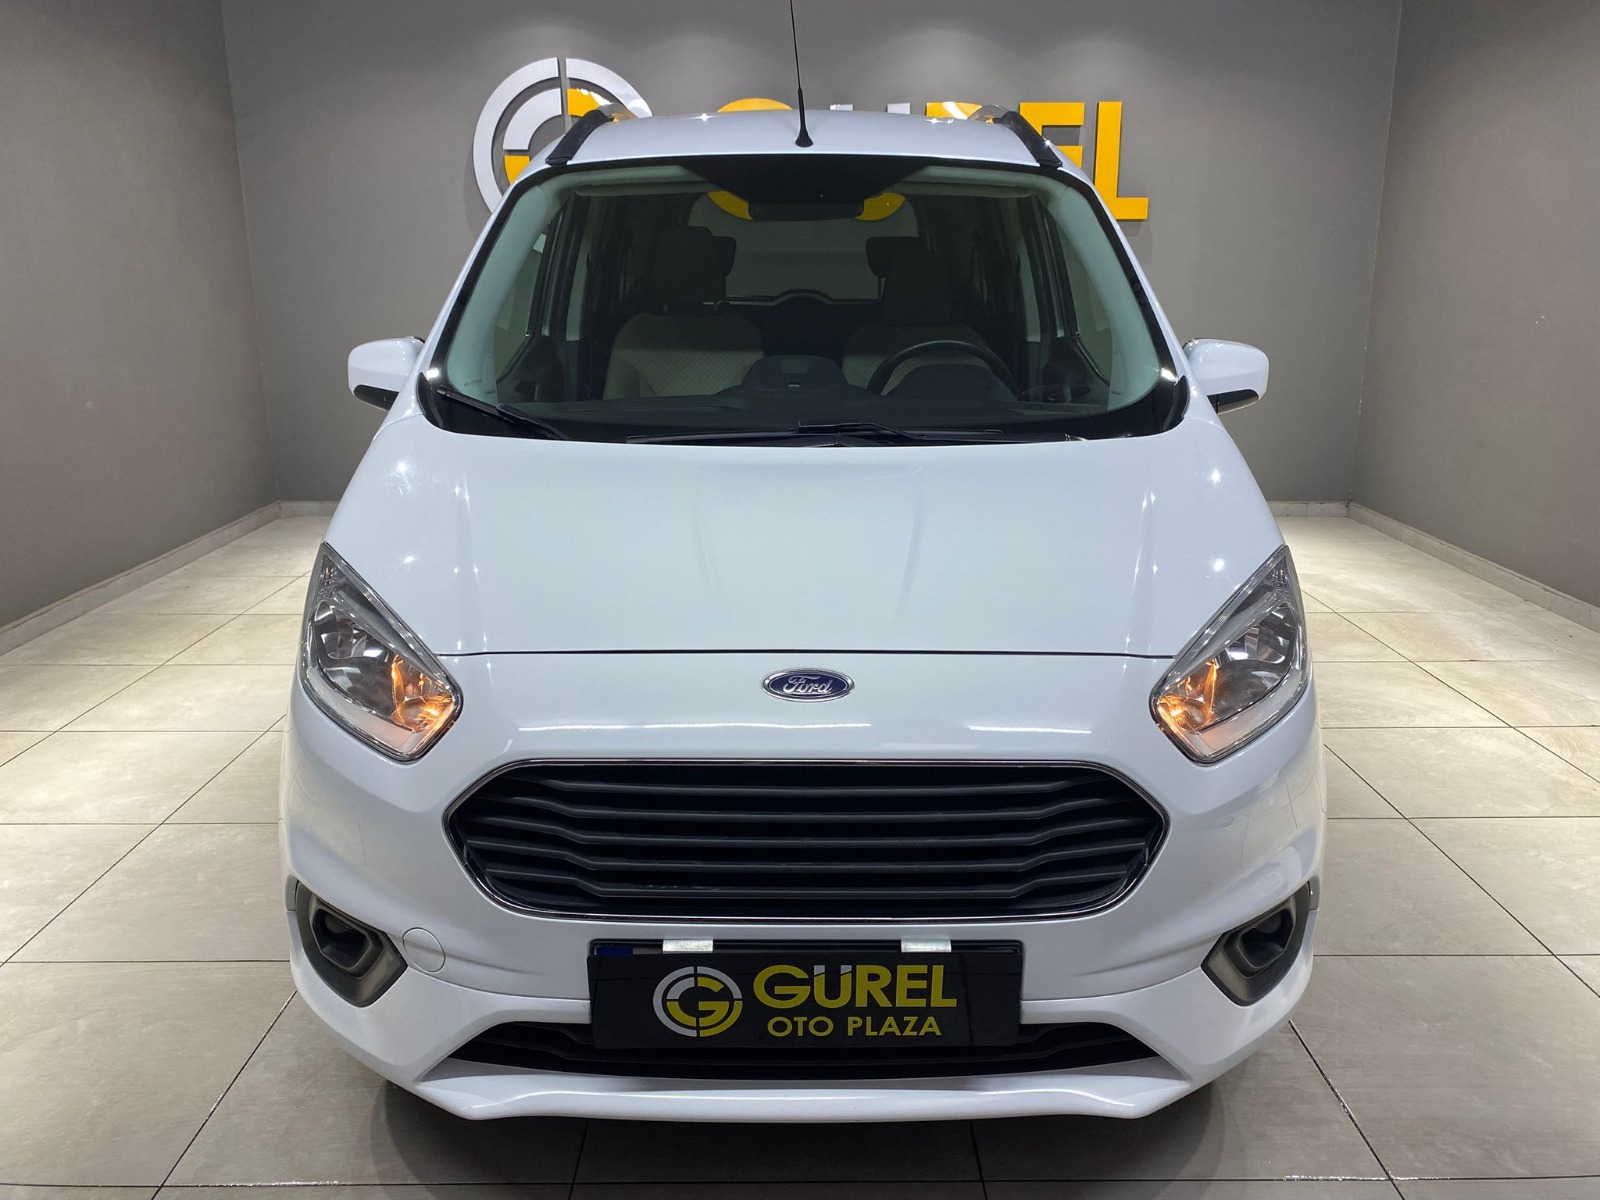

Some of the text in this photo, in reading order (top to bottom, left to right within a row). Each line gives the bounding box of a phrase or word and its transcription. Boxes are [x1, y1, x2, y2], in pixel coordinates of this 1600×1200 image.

[783, 675, 833, 695] Ford
[767, 1016, 942, 1037] OTO PLAZA
